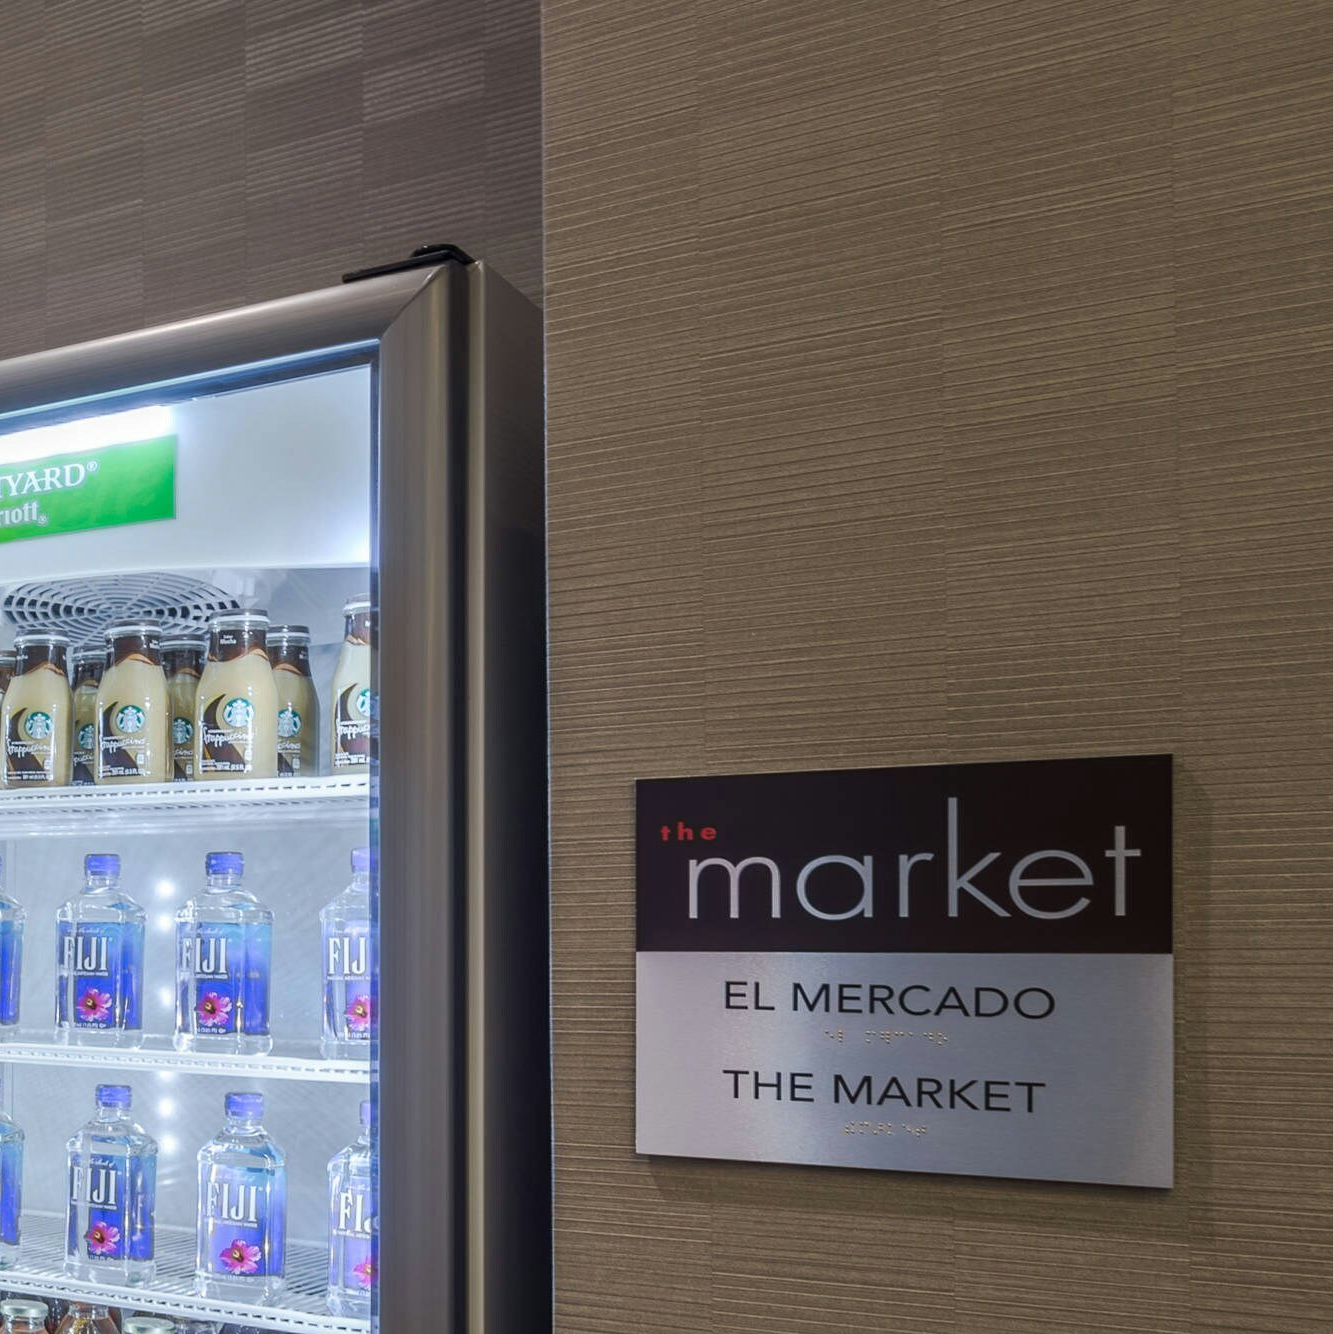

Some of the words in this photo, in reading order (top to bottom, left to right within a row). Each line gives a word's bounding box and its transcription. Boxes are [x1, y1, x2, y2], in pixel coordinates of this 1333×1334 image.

[660, 821, 718, 842] the
[688, 796, 1142, 921] market
[328, 936, 368, 976] FIJ
[723, 979, 776, 1012] EL
[791, 981, 1056, 1021] MERCADO
[722, 1069, 816, 1104] THE
[832, 1073, 1047, 1114] MARKET
[206, 1181, 258, 1223] FIJI
